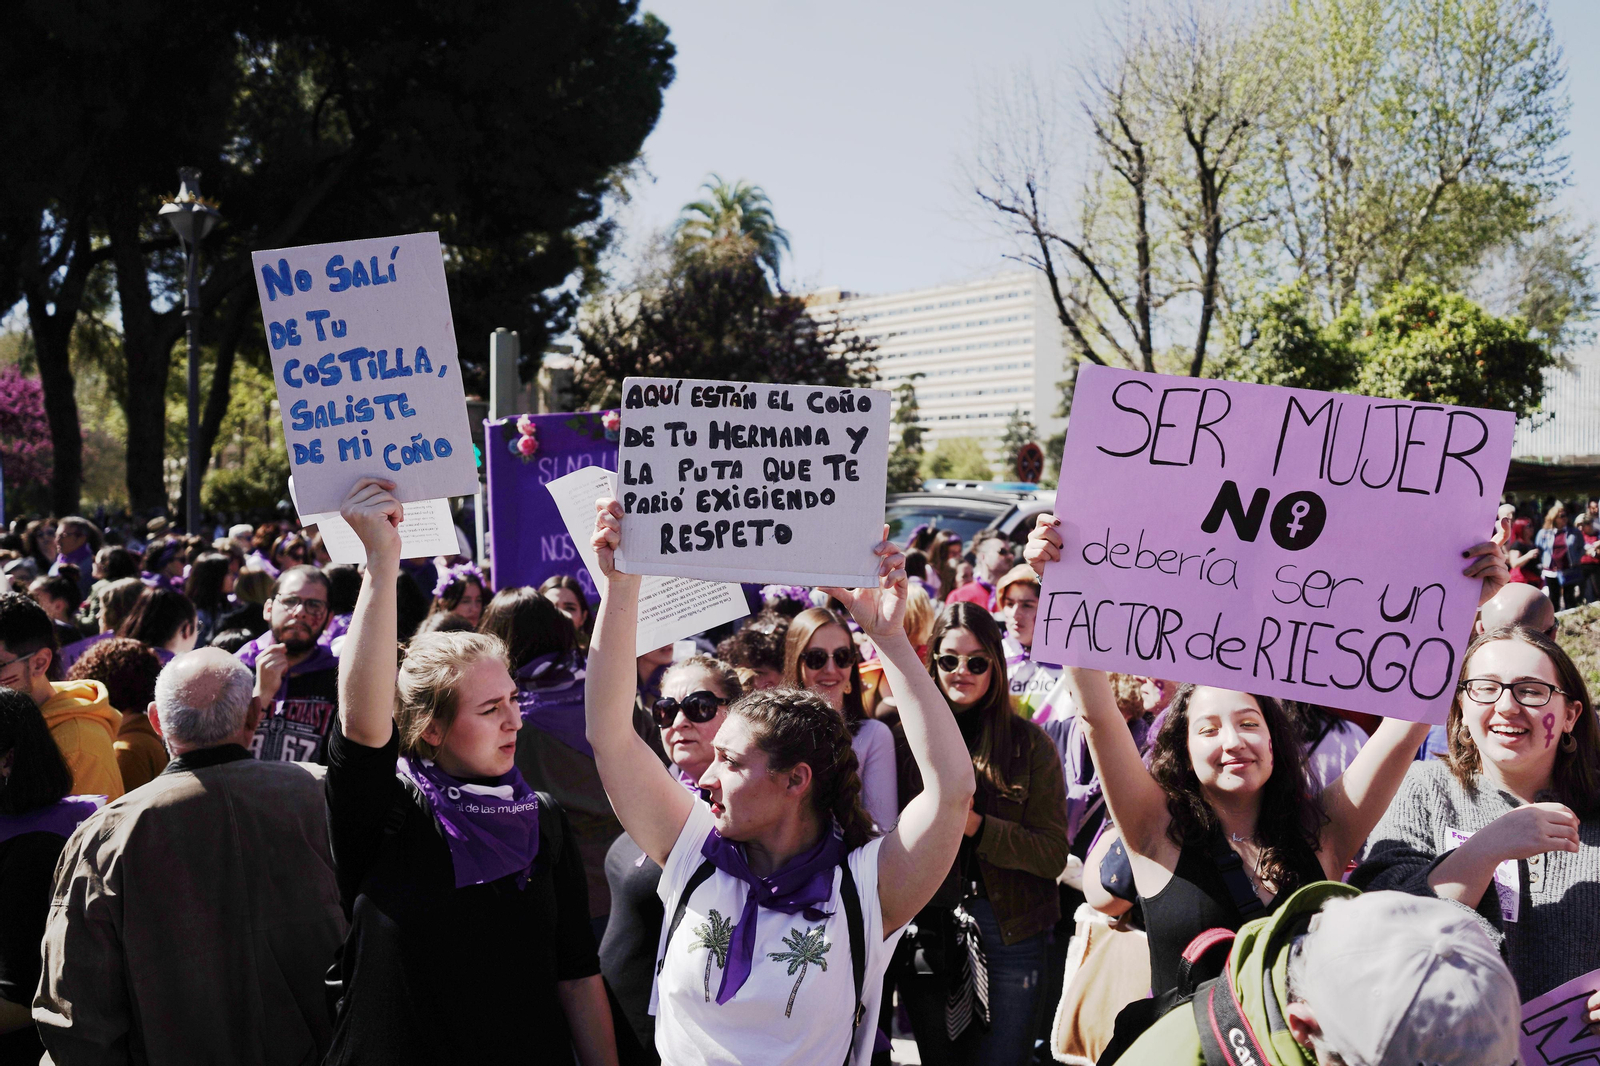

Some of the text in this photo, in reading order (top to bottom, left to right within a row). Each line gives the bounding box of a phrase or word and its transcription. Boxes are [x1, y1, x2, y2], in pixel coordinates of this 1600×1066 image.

[269, 319, 301, 350] DE
[625, 380, 871, 413] AQUÍ ESTÁN EL COÑO
[293, 439, 324, 465] DE
[383, 433, 453, 471] COÑO
[624, 426, 654, 447] DE
[709, 421, 830, 450] HERMANA
[846, 426, 869, 454] Y
[1096, 380, 1489, 497] SER MUJER
[624, 460, 653, 485] LA
[679, 458, 742, 482] PUTA
[763, 457, 811, 483] QUE
[823, 454, 859, 481] TE
[1200, 480, 1327, 550] NO
[660, 519, 792, 555] RESPETO
[1082, 528, 1446, 631] debería ser un
[1043, 591, 1455, 701] FACTOR de RIESGO
[281, 734, 317, 762] 67
[465, 803, 479, 814] de
[481, 804, 495, 814] las
[497, 801, 534, 814] mujeres
